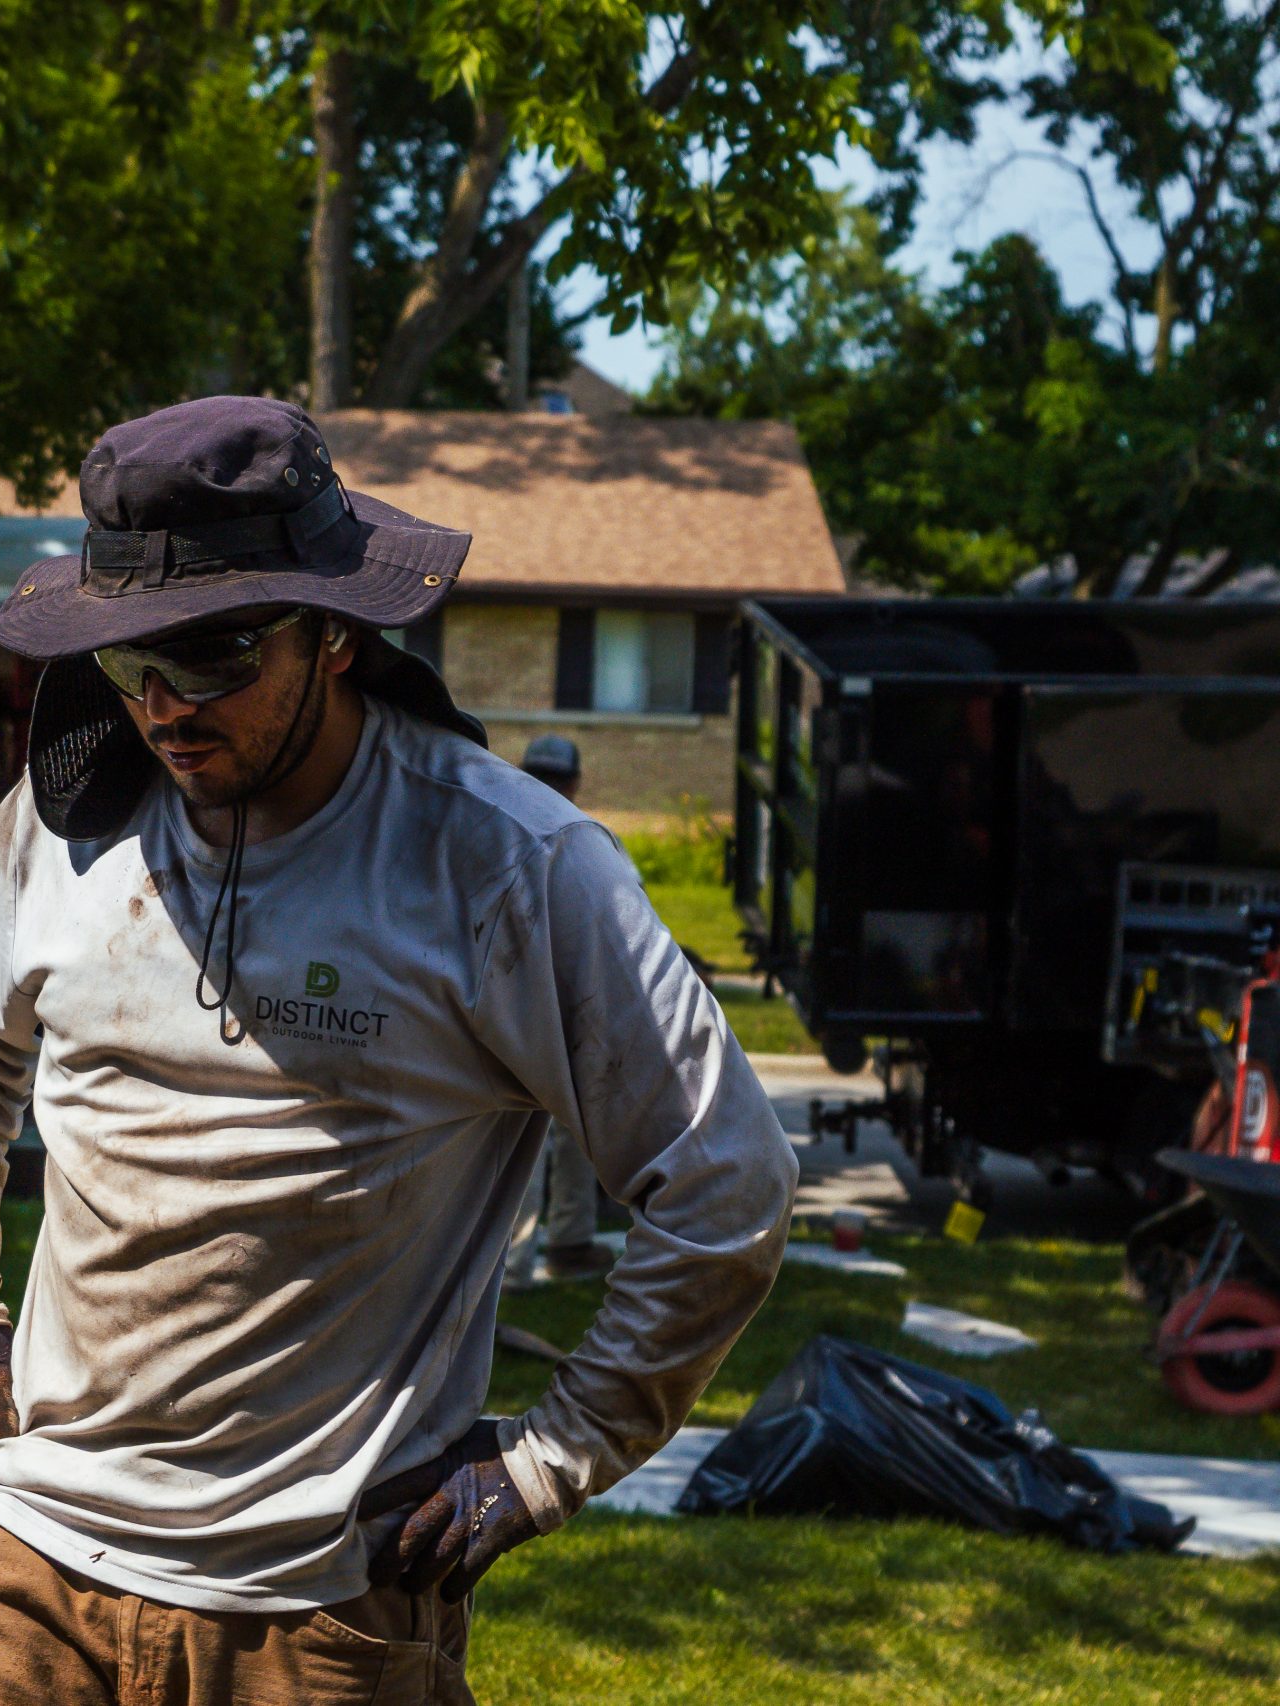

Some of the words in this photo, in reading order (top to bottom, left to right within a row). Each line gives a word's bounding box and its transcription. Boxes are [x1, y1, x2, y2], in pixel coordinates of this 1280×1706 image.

[256, 996, 389, 1037] DISTINCT
[272, 1026, 324, 1041] OUTDOOR
[329, 1035, 368, 1049] LIVING
